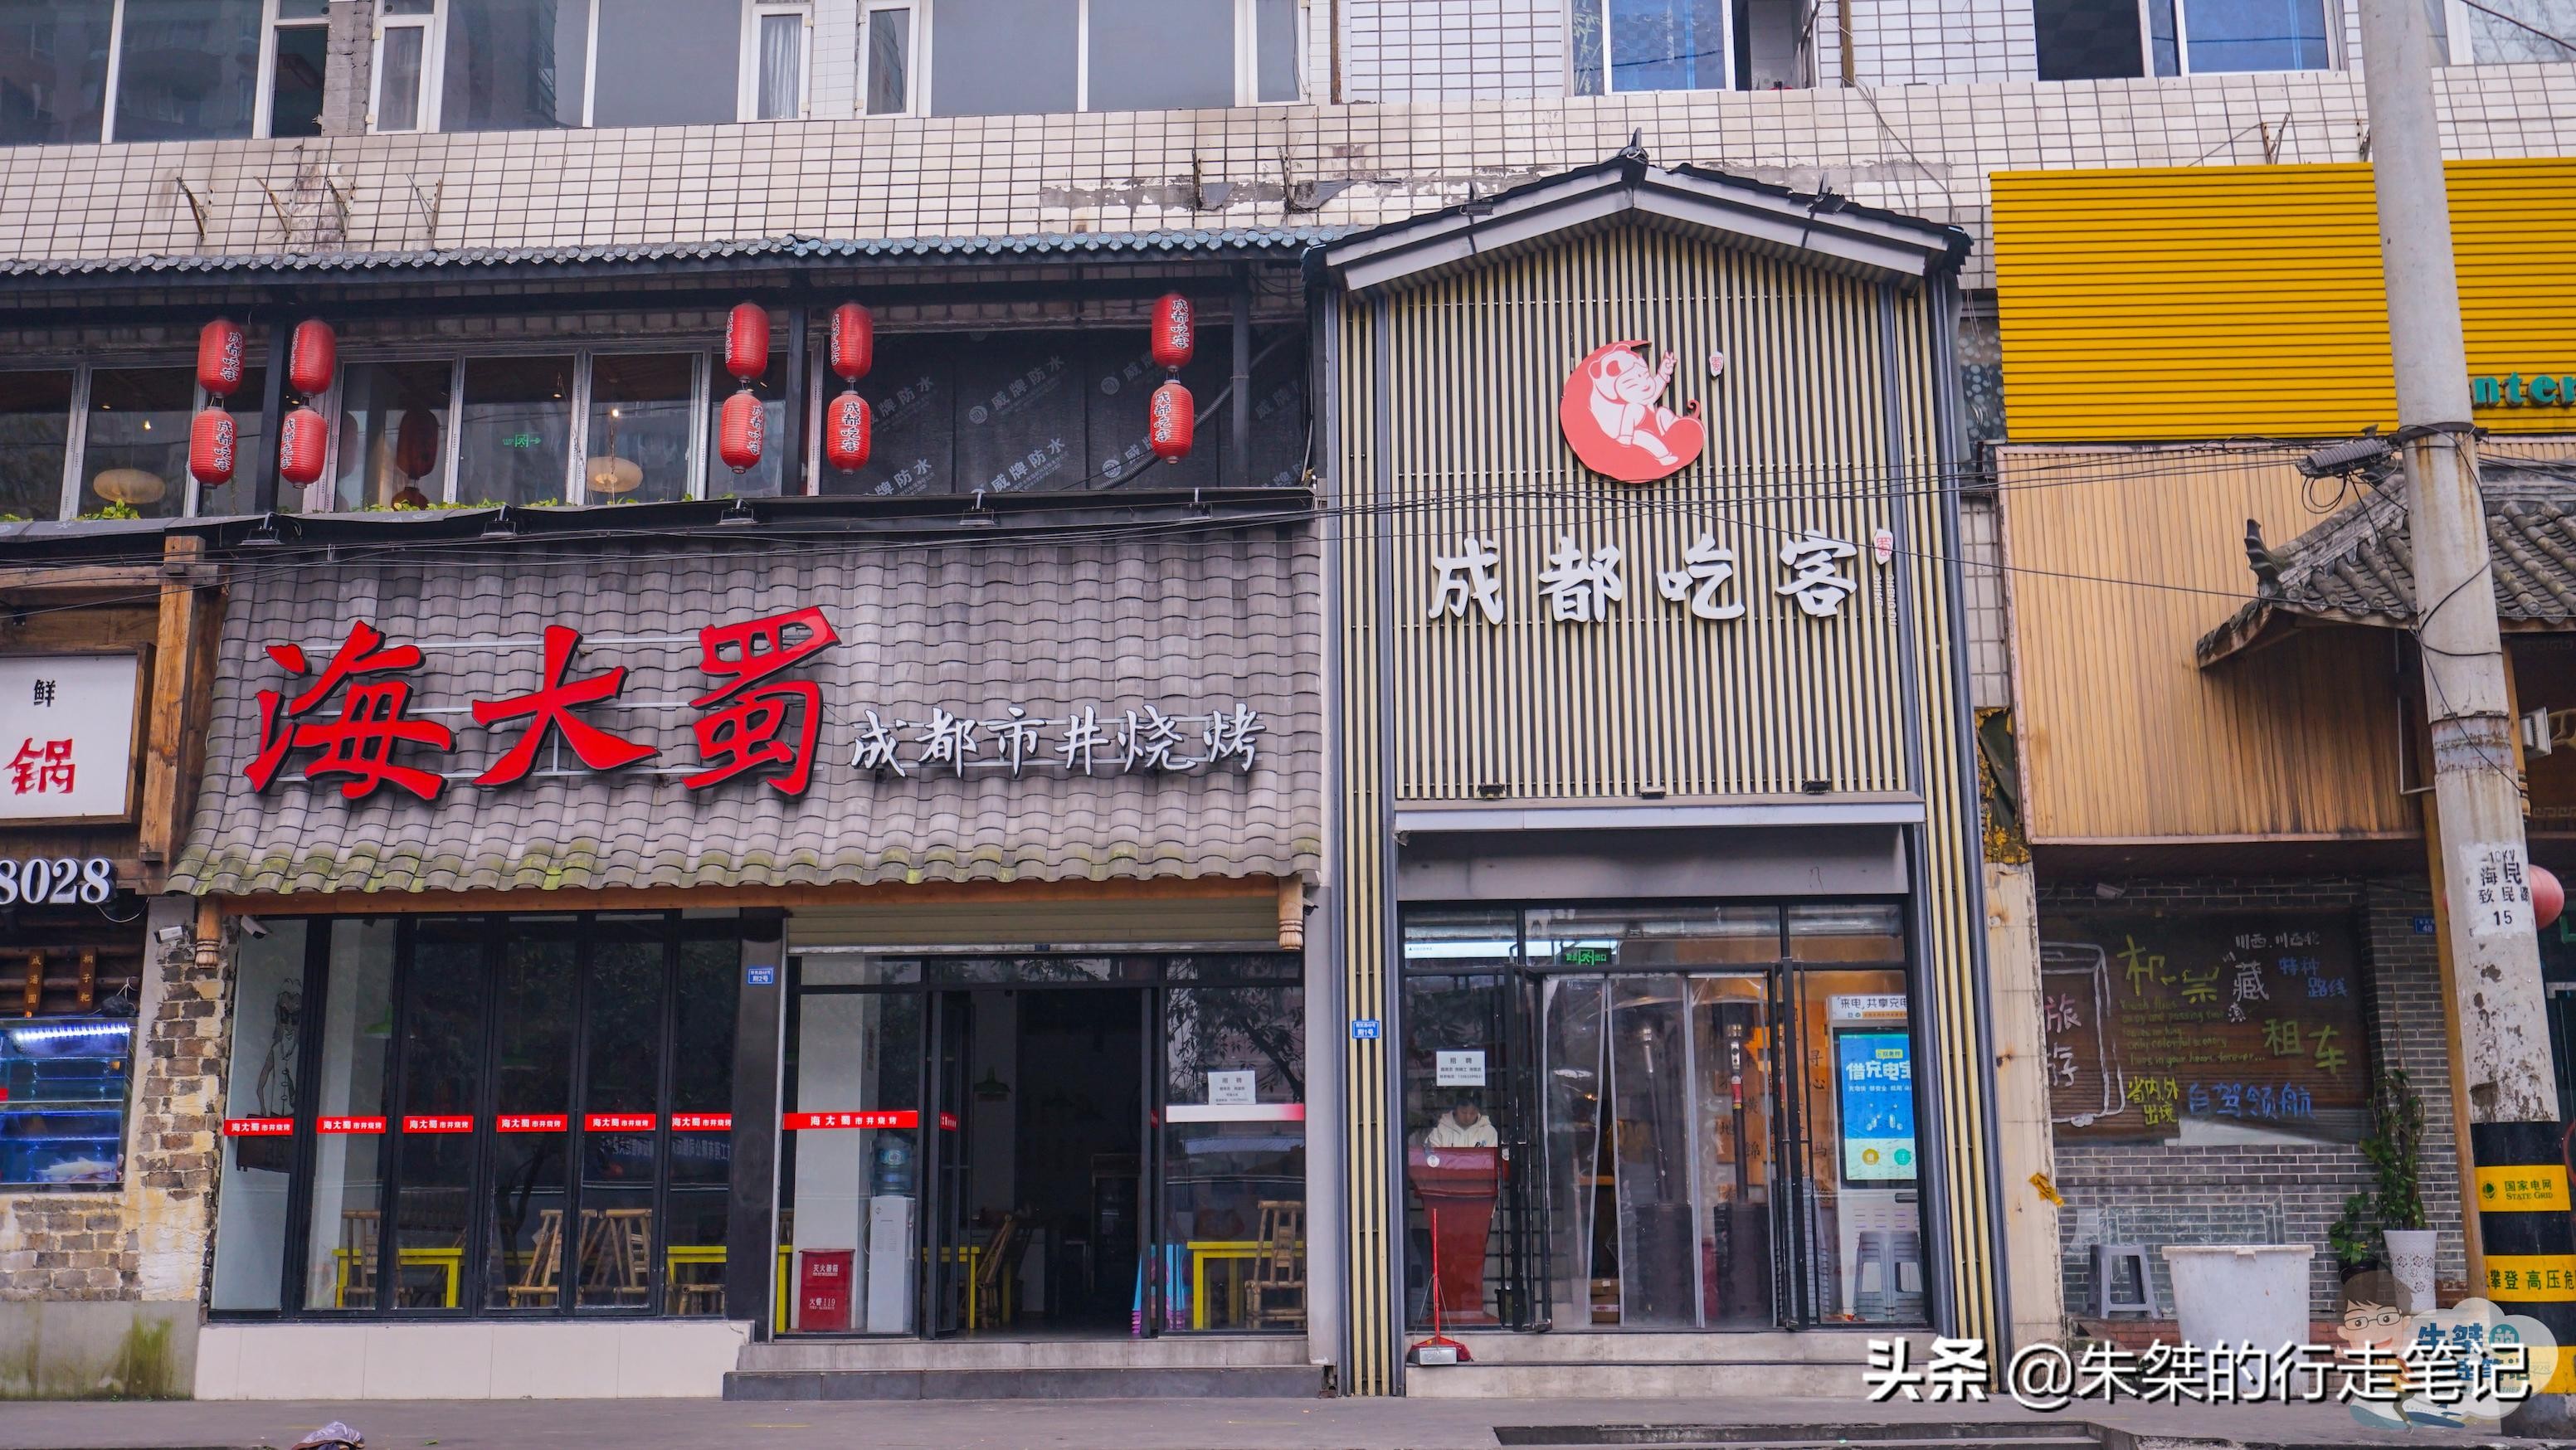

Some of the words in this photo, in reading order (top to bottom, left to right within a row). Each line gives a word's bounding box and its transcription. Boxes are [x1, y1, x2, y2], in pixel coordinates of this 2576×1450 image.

[1171, 299, 1190, 349] 成都吃客
[841, 401, 861, 452] 成都吃客
[1154, 390, 1172, 442] 成都吃客
[213, 420, 233, 472] 成都吃客
[991, 437, 1065, 494] 威牌防水
[1428, 529, 1858, 625] 成都吃客
[33, 679, 56, 707] 鲜
[243, 606, 842, 800] 海大蜀
[3, 737, 75, 795] 锅
[850, 703, 1267, 778] 成都市井烧烤
[2493, 910, 2512, 926] 15
[2262, 1019, 2348, 1075] 租车
[811, 1115, 851, 1126] 海大蜀
[855, 1117, 897, 1126] 市井烧烤
[2505, 1180, 2552, 1191] 国家电网
[2486, 1270, 2519, 1290] 攀登
[2526, 1270, 2576, 1290] 高压危
